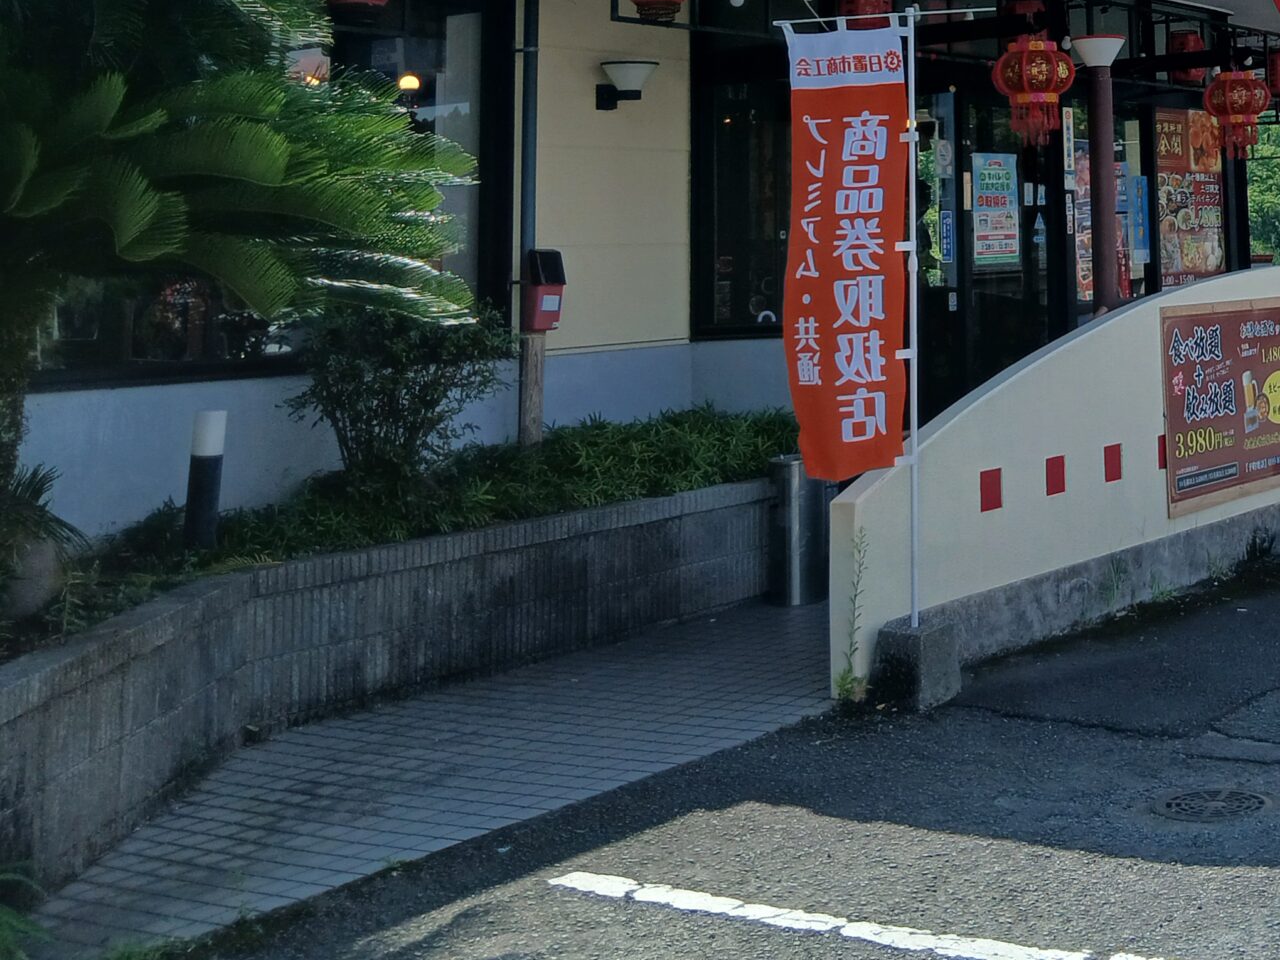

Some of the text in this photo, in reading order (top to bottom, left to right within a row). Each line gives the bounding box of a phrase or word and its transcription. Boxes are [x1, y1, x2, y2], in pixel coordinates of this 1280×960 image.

[1169, 324, 1223, 366] 食べ放題
[1184, 379, 1236, 424] 飲み放題
[1175, 426, 1223, 458] 3,980円
